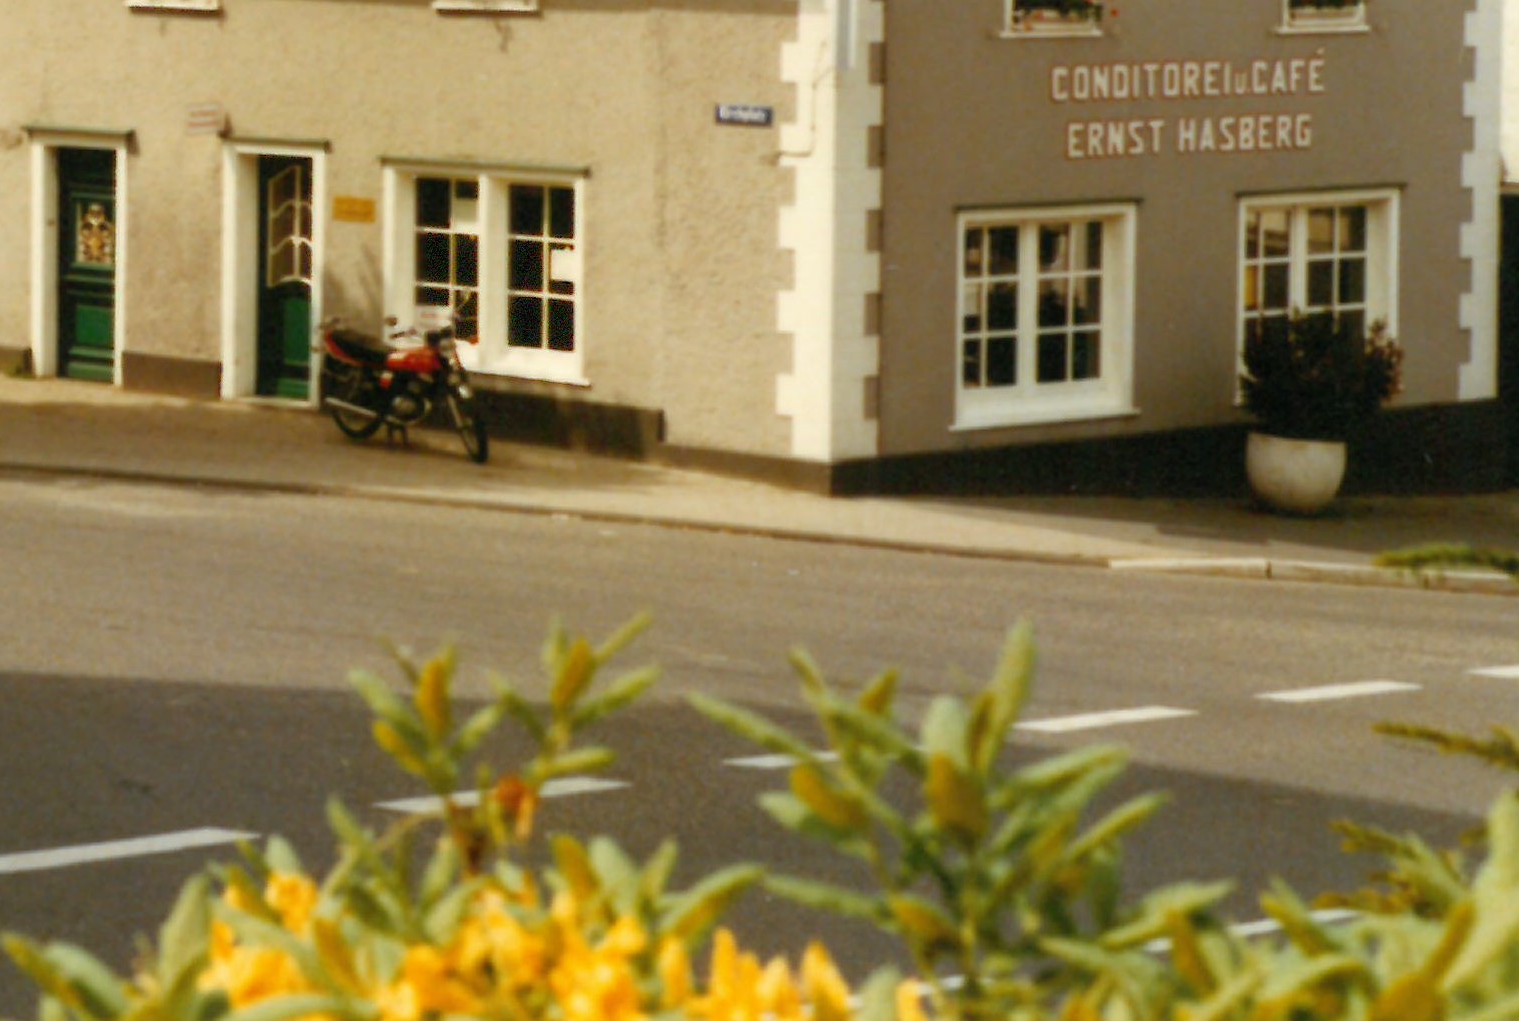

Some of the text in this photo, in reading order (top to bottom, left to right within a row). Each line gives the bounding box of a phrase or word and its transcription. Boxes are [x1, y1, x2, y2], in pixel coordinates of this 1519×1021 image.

[1051, 61, 1232, 100] CONDITOREI
[1251, 47, 1325, 95] CAFÉ
[1067, 113, 1313, 158] ERNST HASBERG
